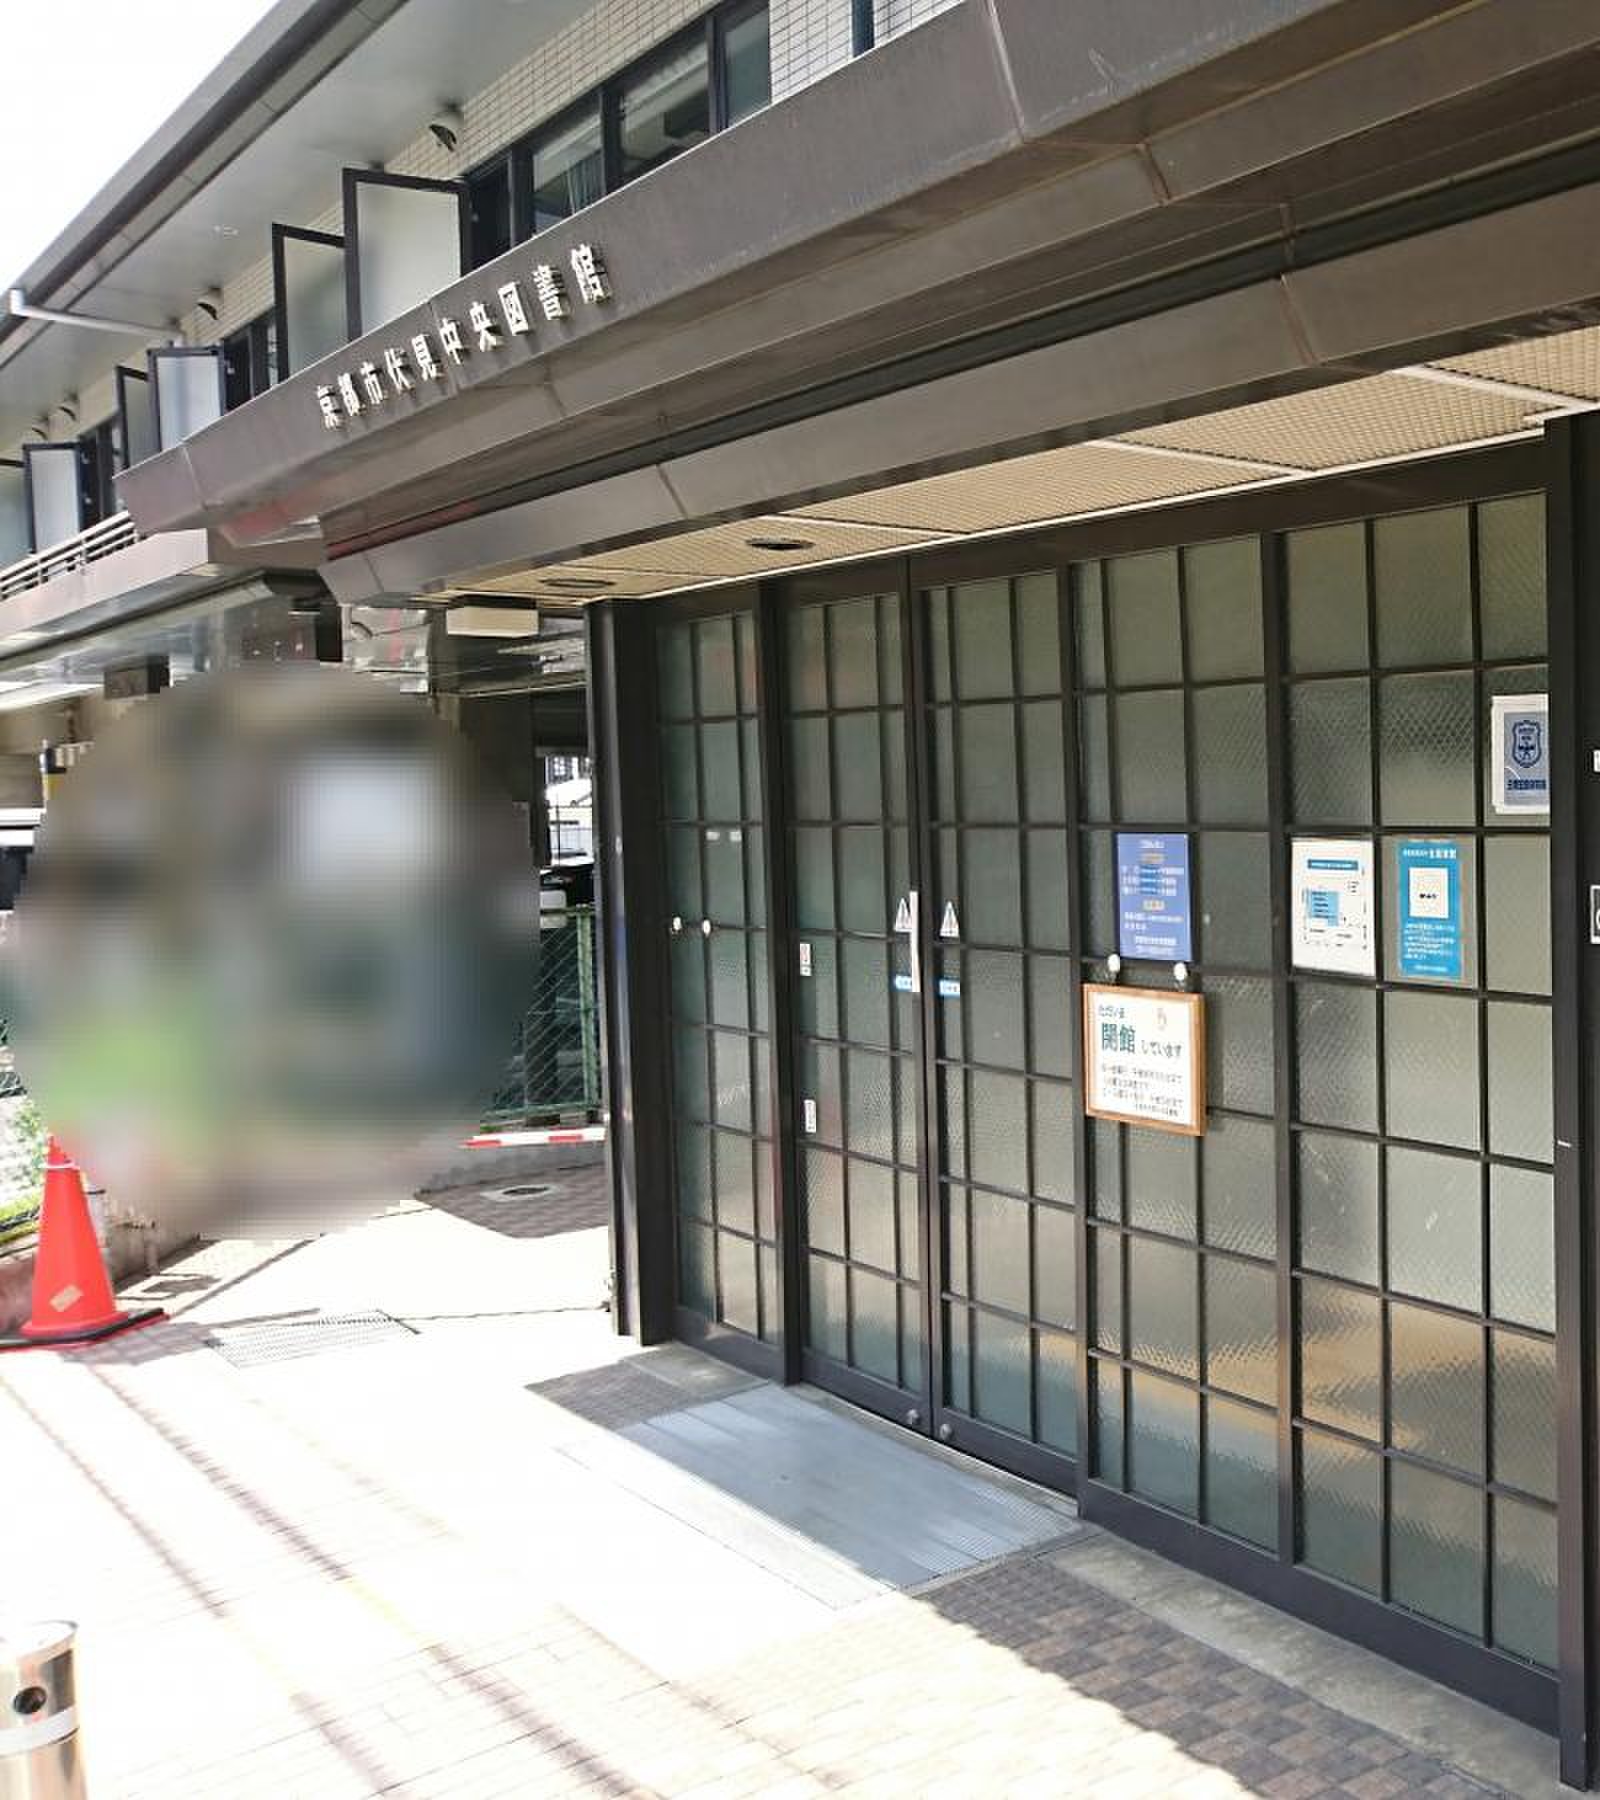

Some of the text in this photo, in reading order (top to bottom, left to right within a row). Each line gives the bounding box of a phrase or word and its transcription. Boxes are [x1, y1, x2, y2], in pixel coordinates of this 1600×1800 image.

[317, 242, 612, 429] 京都市伏見中央図書館
